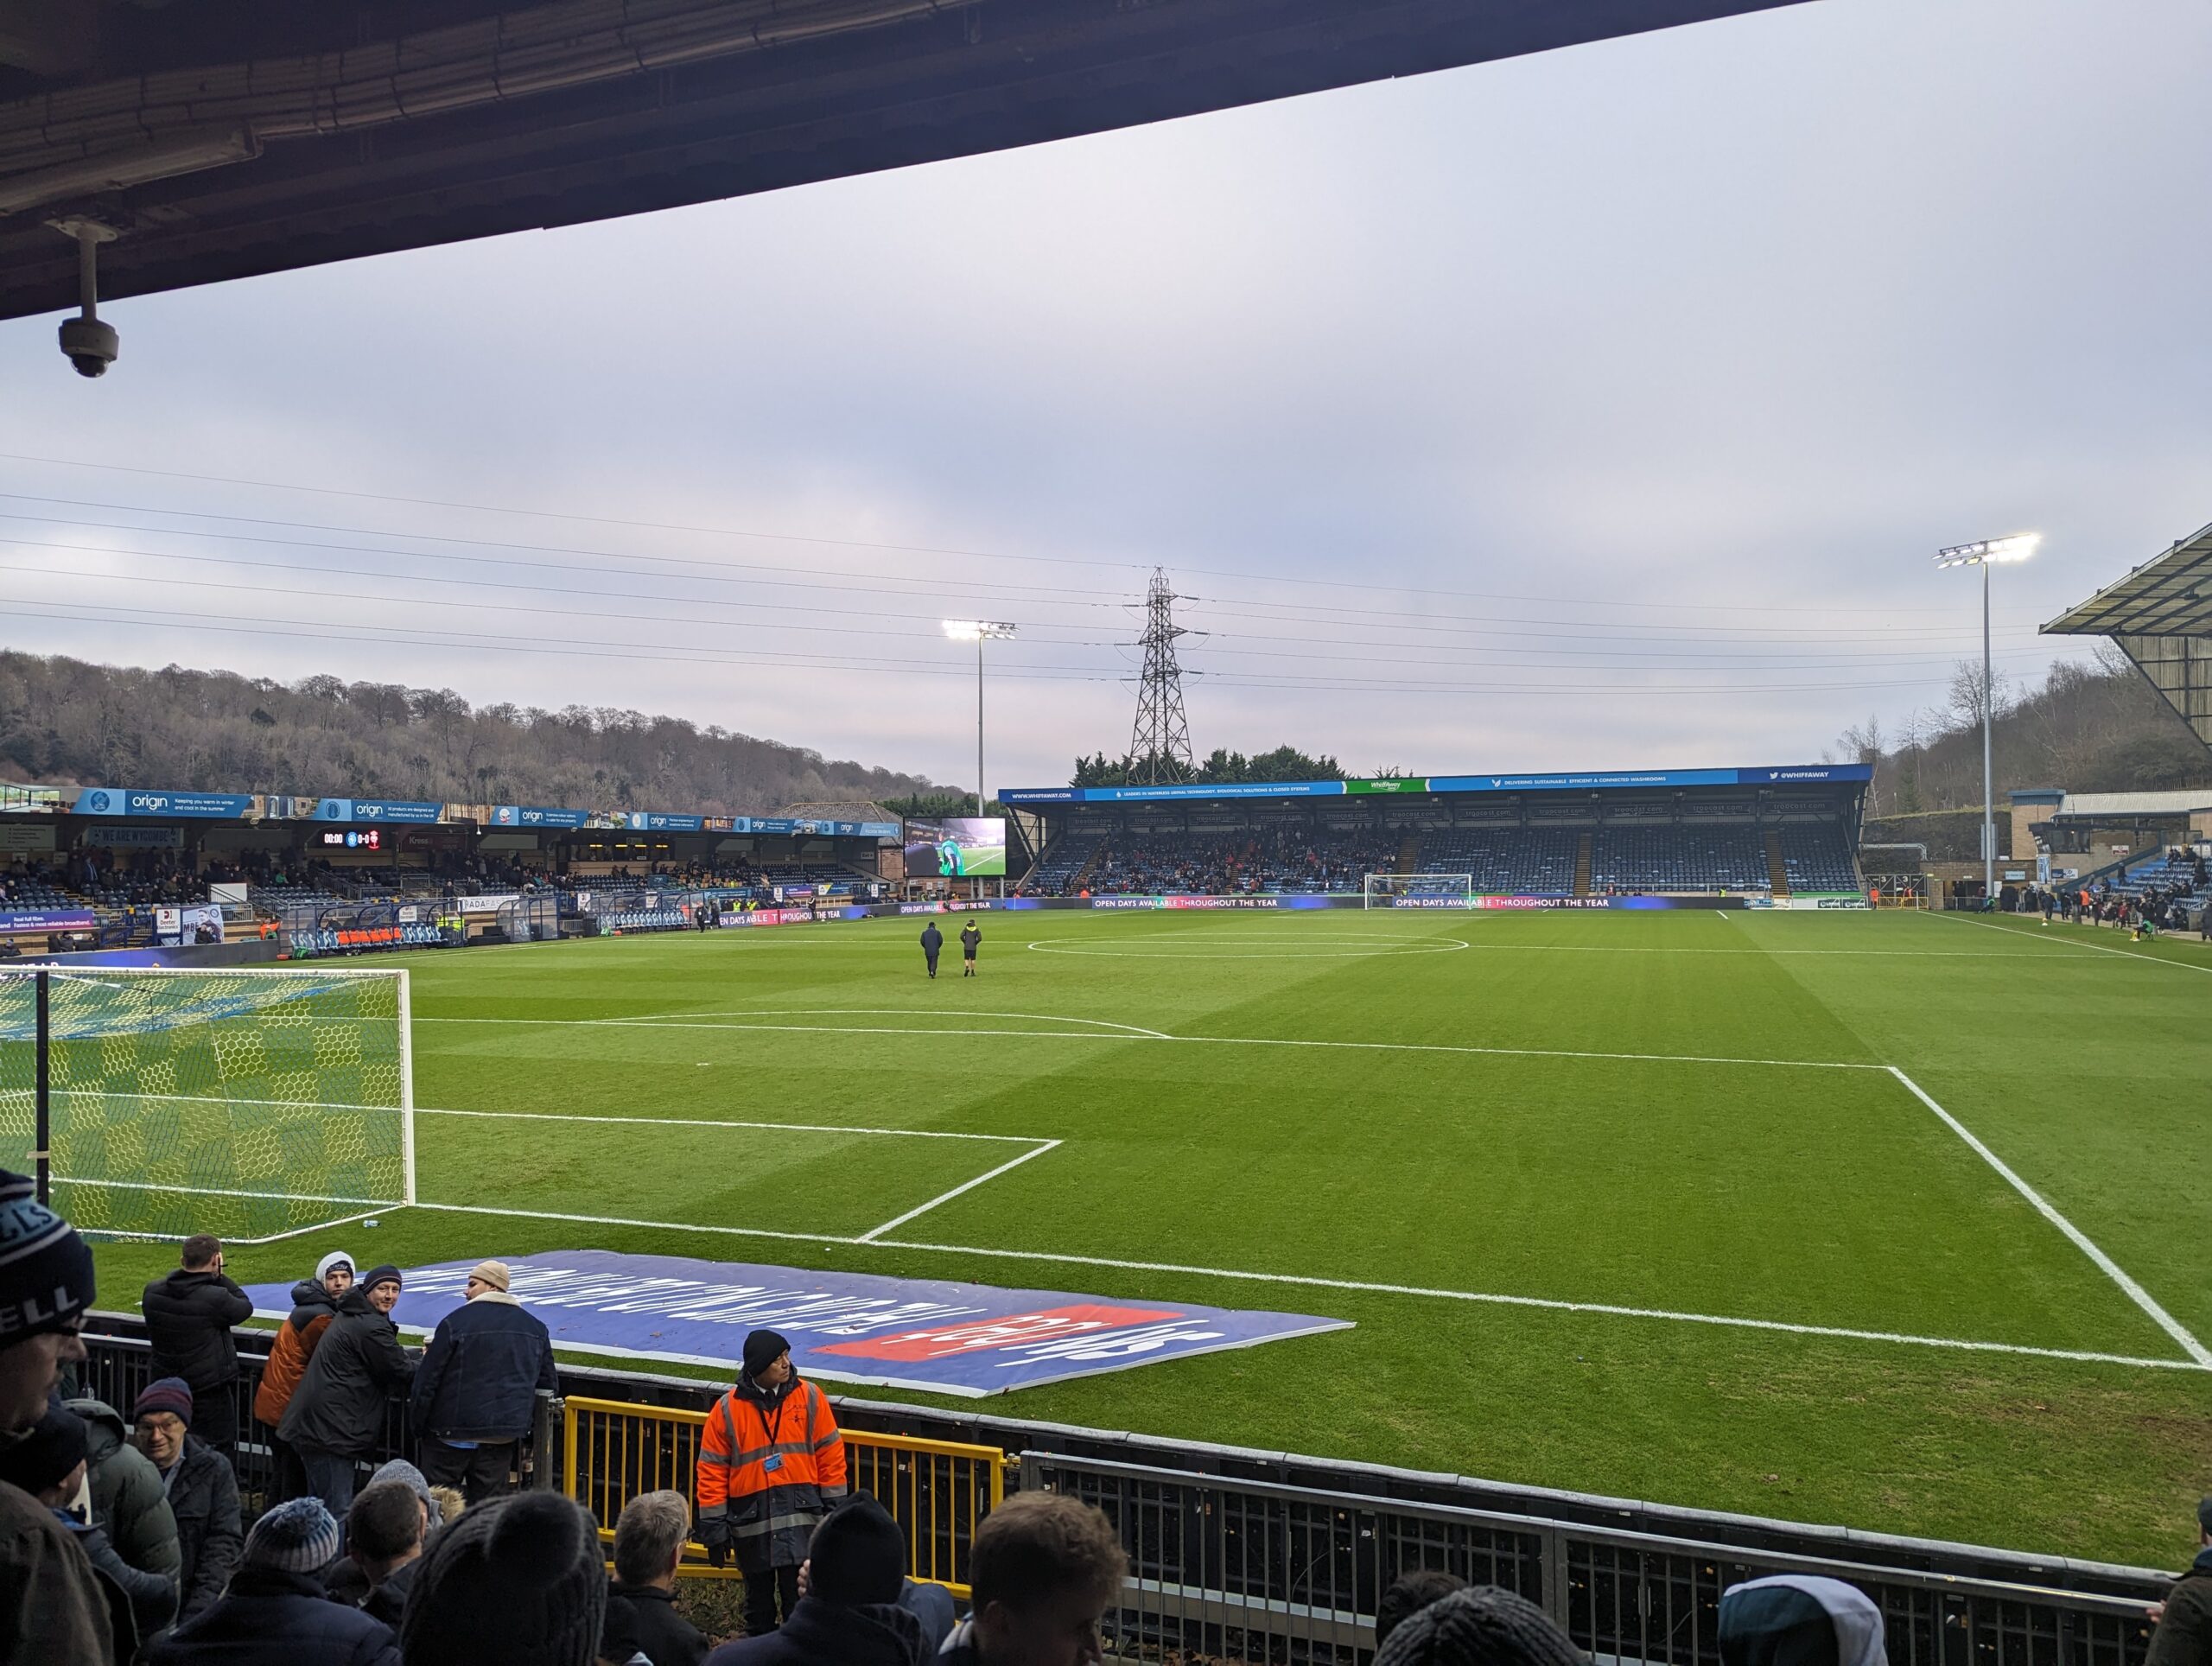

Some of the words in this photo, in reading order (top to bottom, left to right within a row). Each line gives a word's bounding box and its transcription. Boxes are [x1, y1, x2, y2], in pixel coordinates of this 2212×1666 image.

[132, 794, 168, 810] origin
[356, 804, 383, 817] origin
[522, 810, 543, 822] origin
[650, 816, 666, 826] origin
[102, 830, 115, 842] WE
[116, 830, 130, 842] ARE
[324, 834, 343, 843] 00:00
[358, 834, 370, 844] 0-0
[730, 915, 745, 925] DAYS
